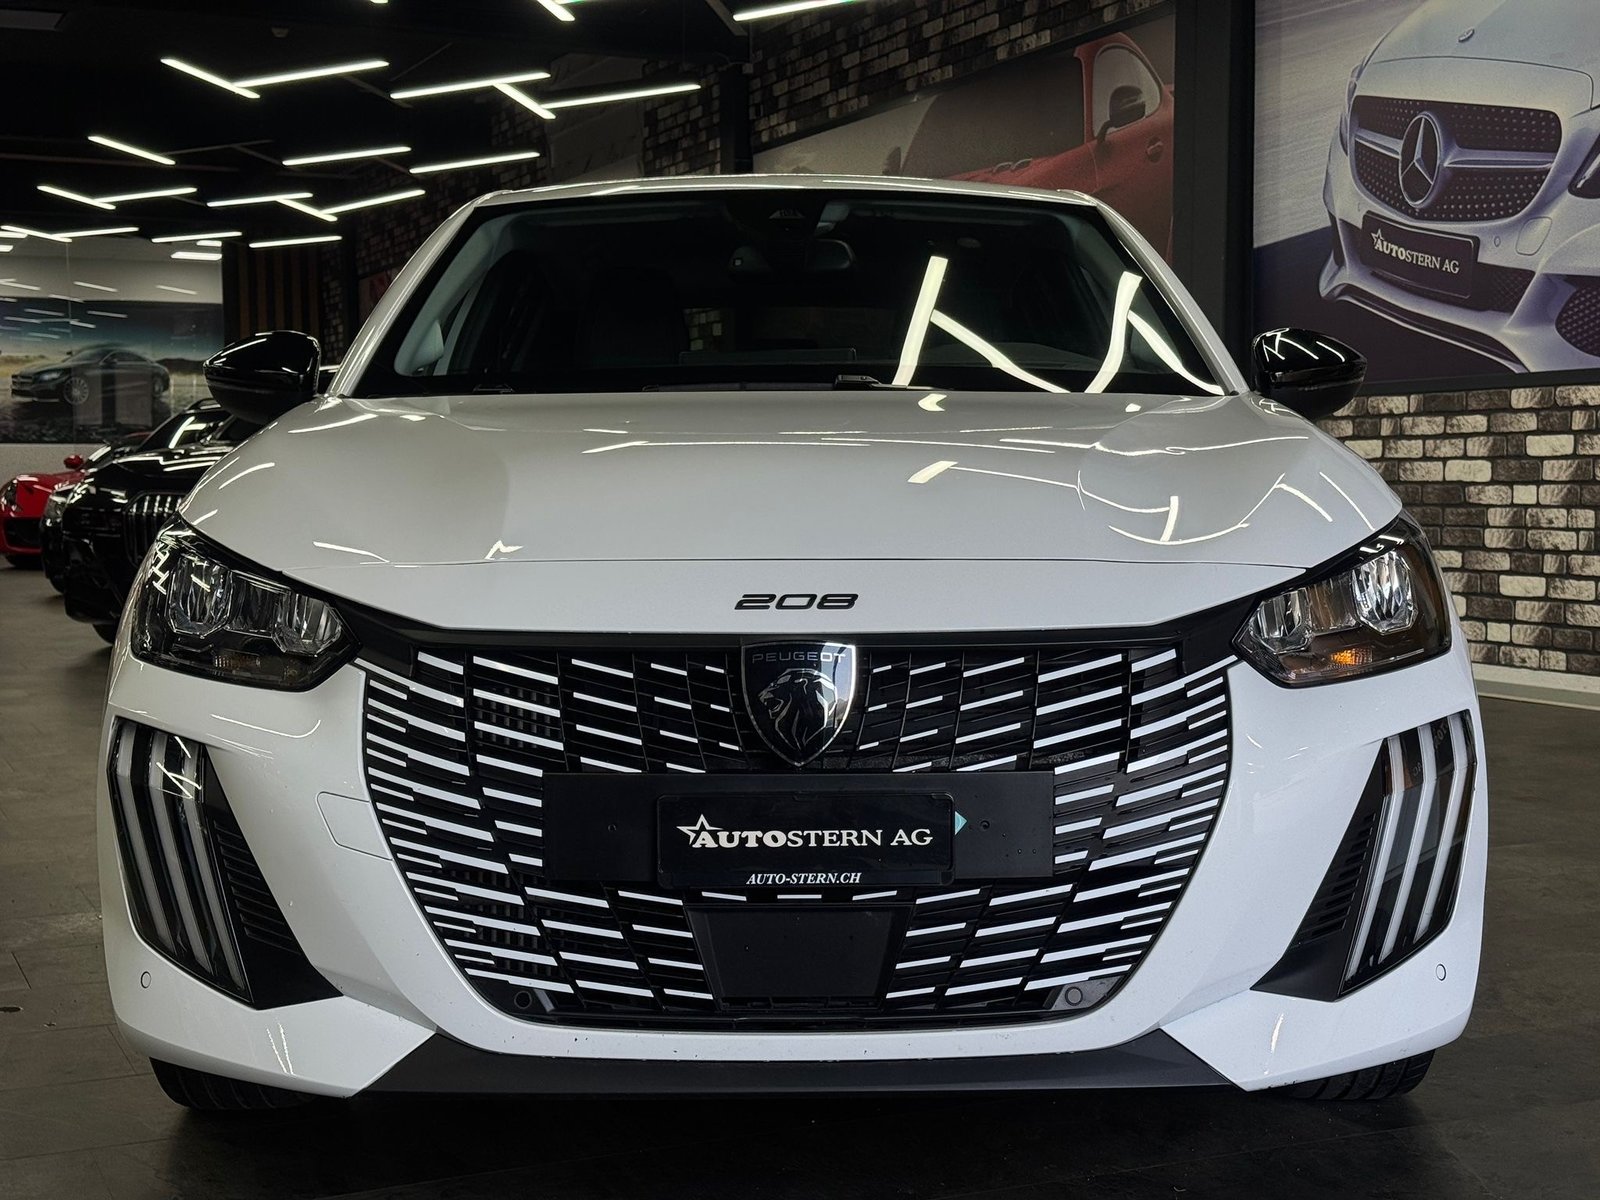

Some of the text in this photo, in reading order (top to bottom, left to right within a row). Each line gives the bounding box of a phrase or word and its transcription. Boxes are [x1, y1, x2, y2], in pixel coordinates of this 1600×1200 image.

[1374, 239, 1460, 274] AUTOSTERN AG
[734, 593, 859, 610] 208
[752, 652, 846, 663] PEUGEOT
[693, 828, 933, 847] AUTOSTERN AG
[746, 872, 862, 885] AUTO-STERN.CH
